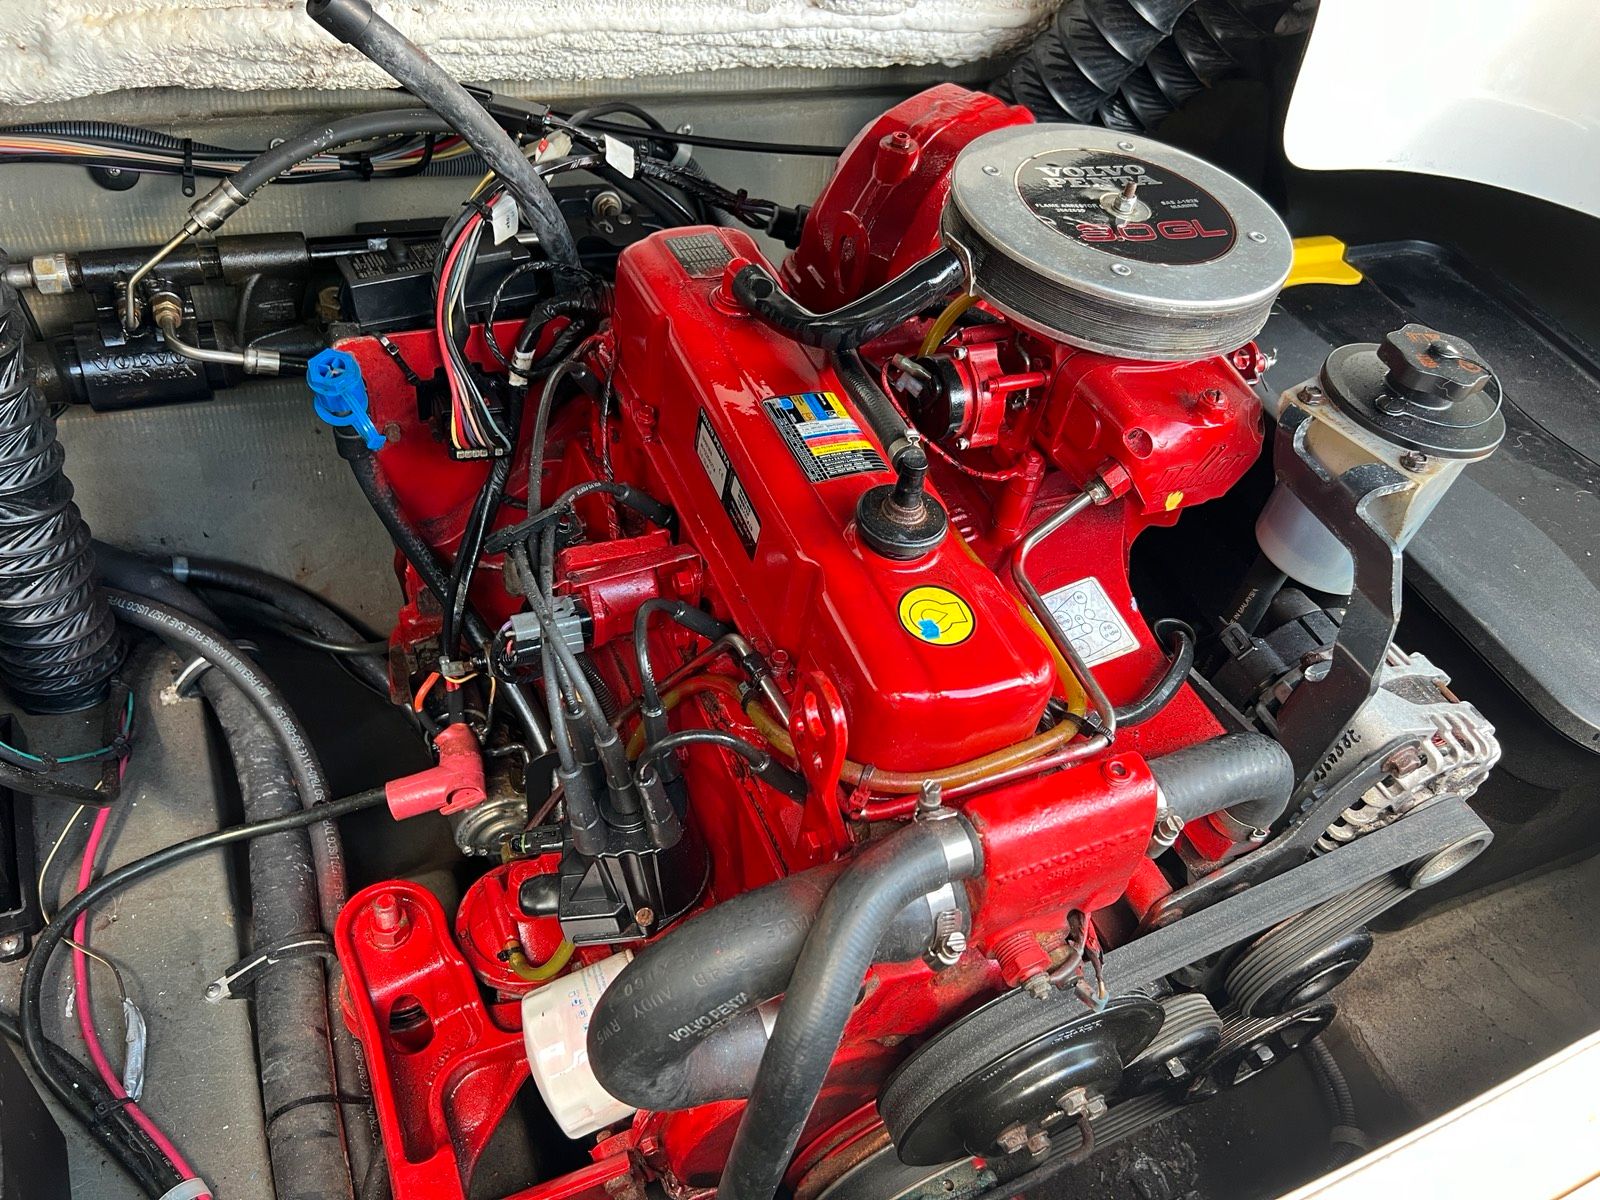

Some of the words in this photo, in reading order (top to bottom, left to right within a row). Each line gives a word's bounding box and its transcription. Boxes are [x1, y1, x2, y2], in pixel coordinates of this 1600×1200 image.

[1035, 164, 1145, 177] VOLVO
[1042, 175, 1163, 188] PENTA
[1076, 219, 1228, 242] 3.0GL
[92, 352, 186, 371] VOLVO
[125, 600, 149, 615] USCG
[1236, 587, 1259, 614] MALAYSIA
[146, 607, 172, 623] J1527
[167, 616, 187, 631] SAE
[184, 624, 205, 642] FUEL
[202, 635, 232, 660] MARINE
[226, 655, 261, 686] PREMIUM
[668, 1016, 711, 1042] VOLVO
[711, 991, 750, 1021] PENTA
